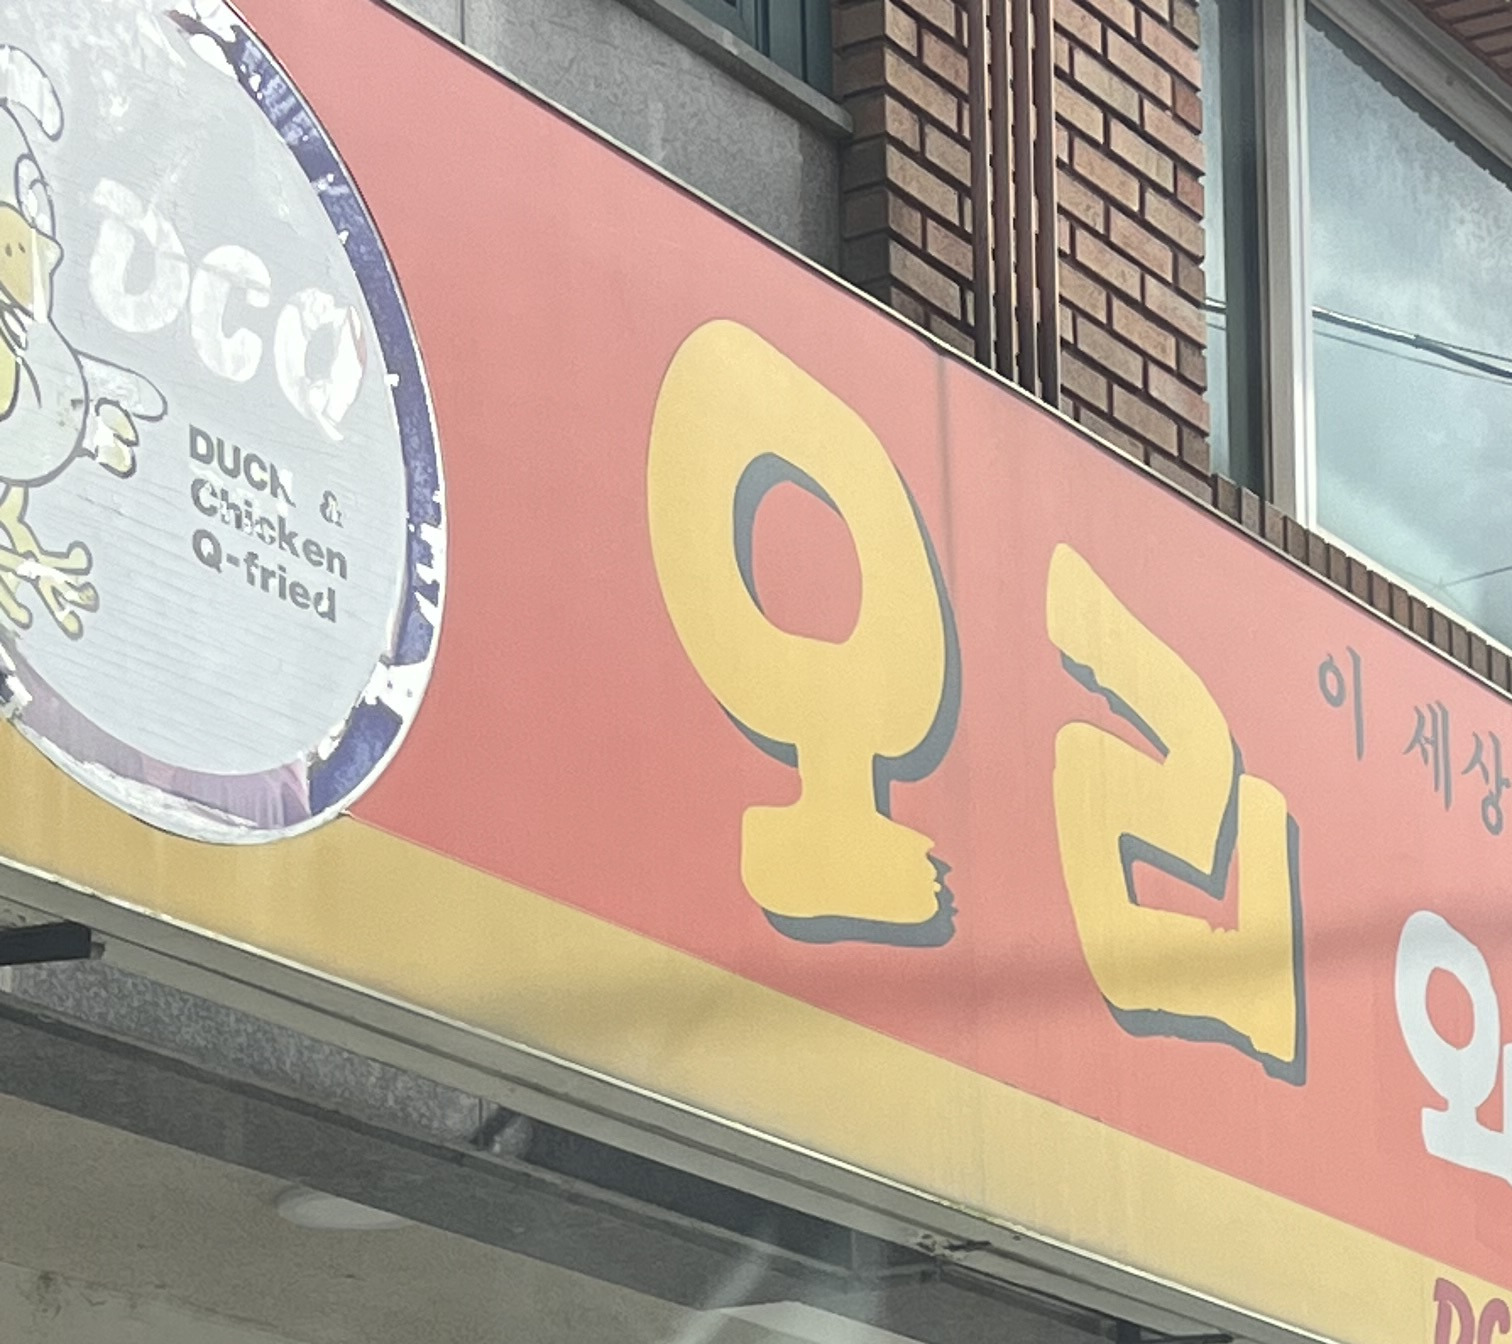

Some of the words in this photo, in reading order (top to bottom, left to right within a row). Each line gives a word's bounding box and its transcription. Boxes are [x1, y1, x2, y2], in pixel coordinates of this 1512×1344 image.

[190, 477, 349, 581] Chicken
[319, 489, 345, 529] &
[191, 528, 337, 624] Q-fried
[1317, 645, 1366, 762] 이
